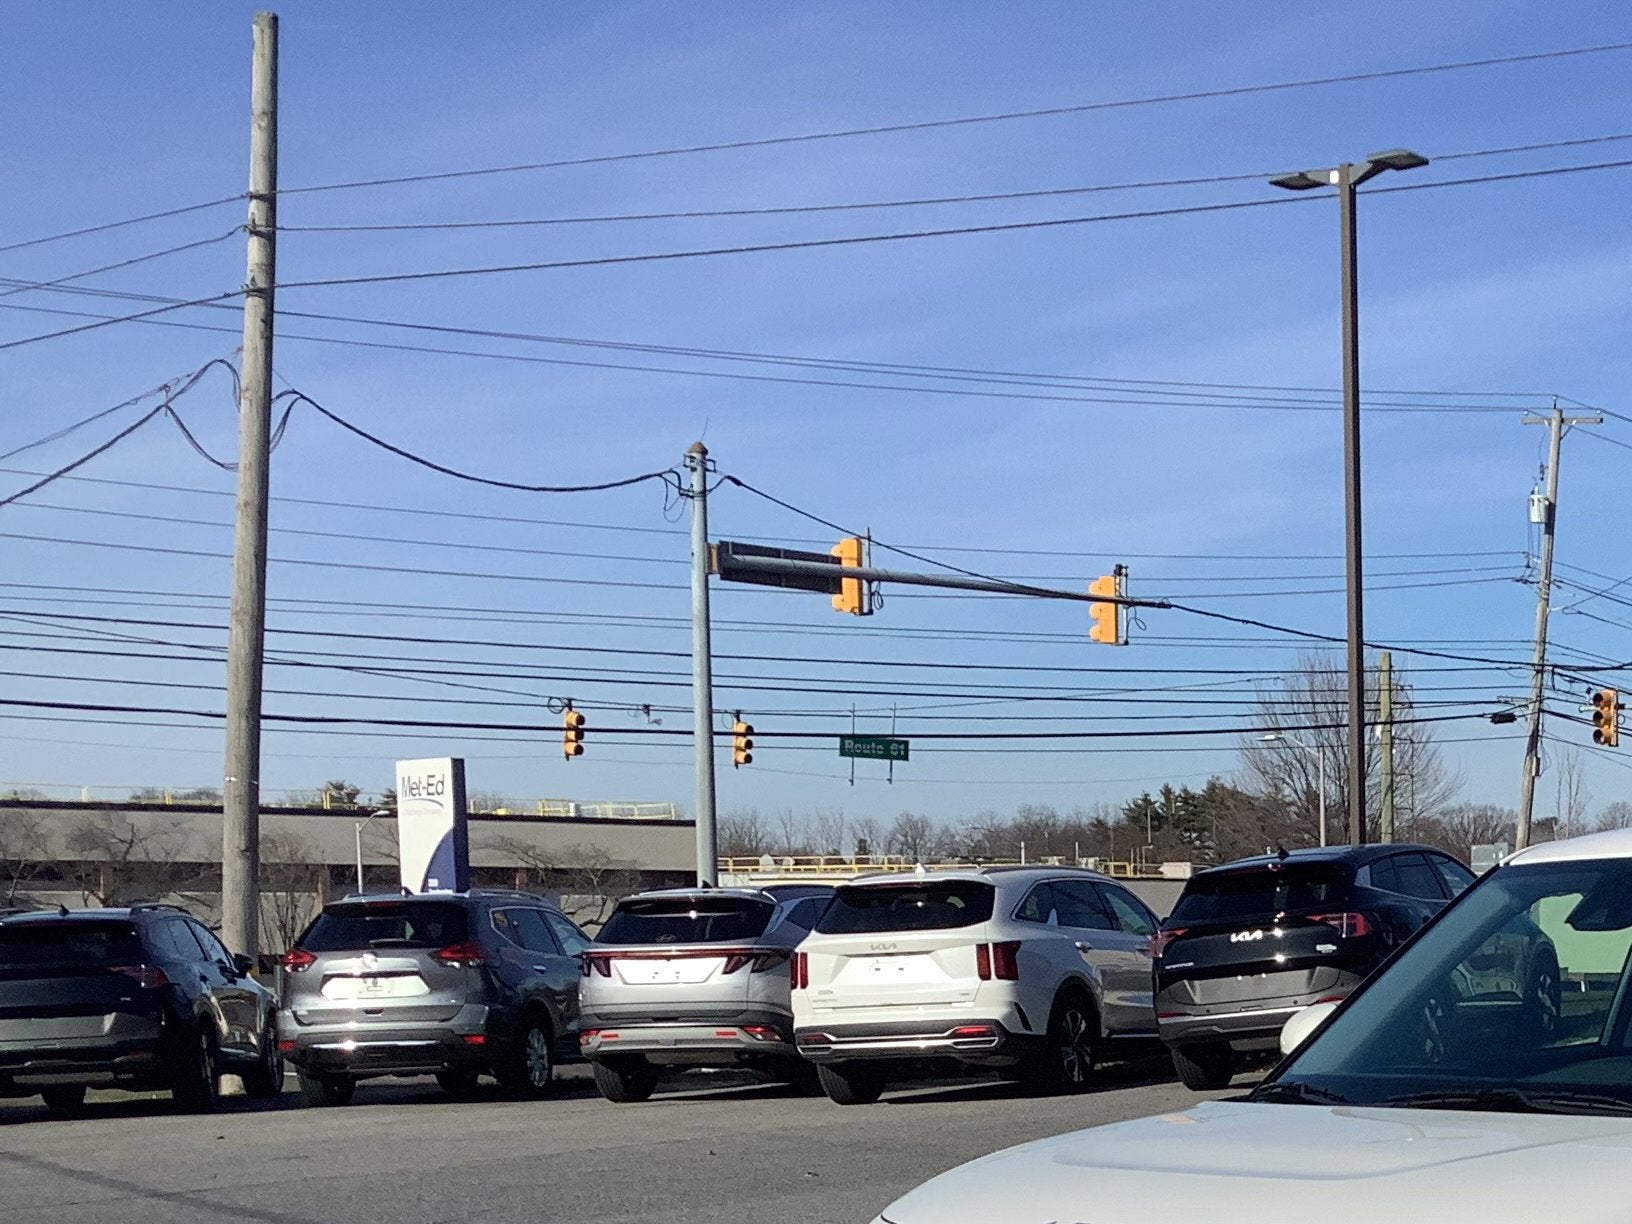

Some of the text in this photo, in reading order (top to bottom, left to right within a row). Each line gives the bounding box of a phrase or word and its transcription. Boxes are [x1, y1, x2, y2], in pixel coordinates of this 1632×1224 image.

[844, 739, 884, 755] Route
[402, 774, 445, 798] Met-Ed
[1231, 929, 1264, 942] KIA
[871, 943, 897, 951] KIA
